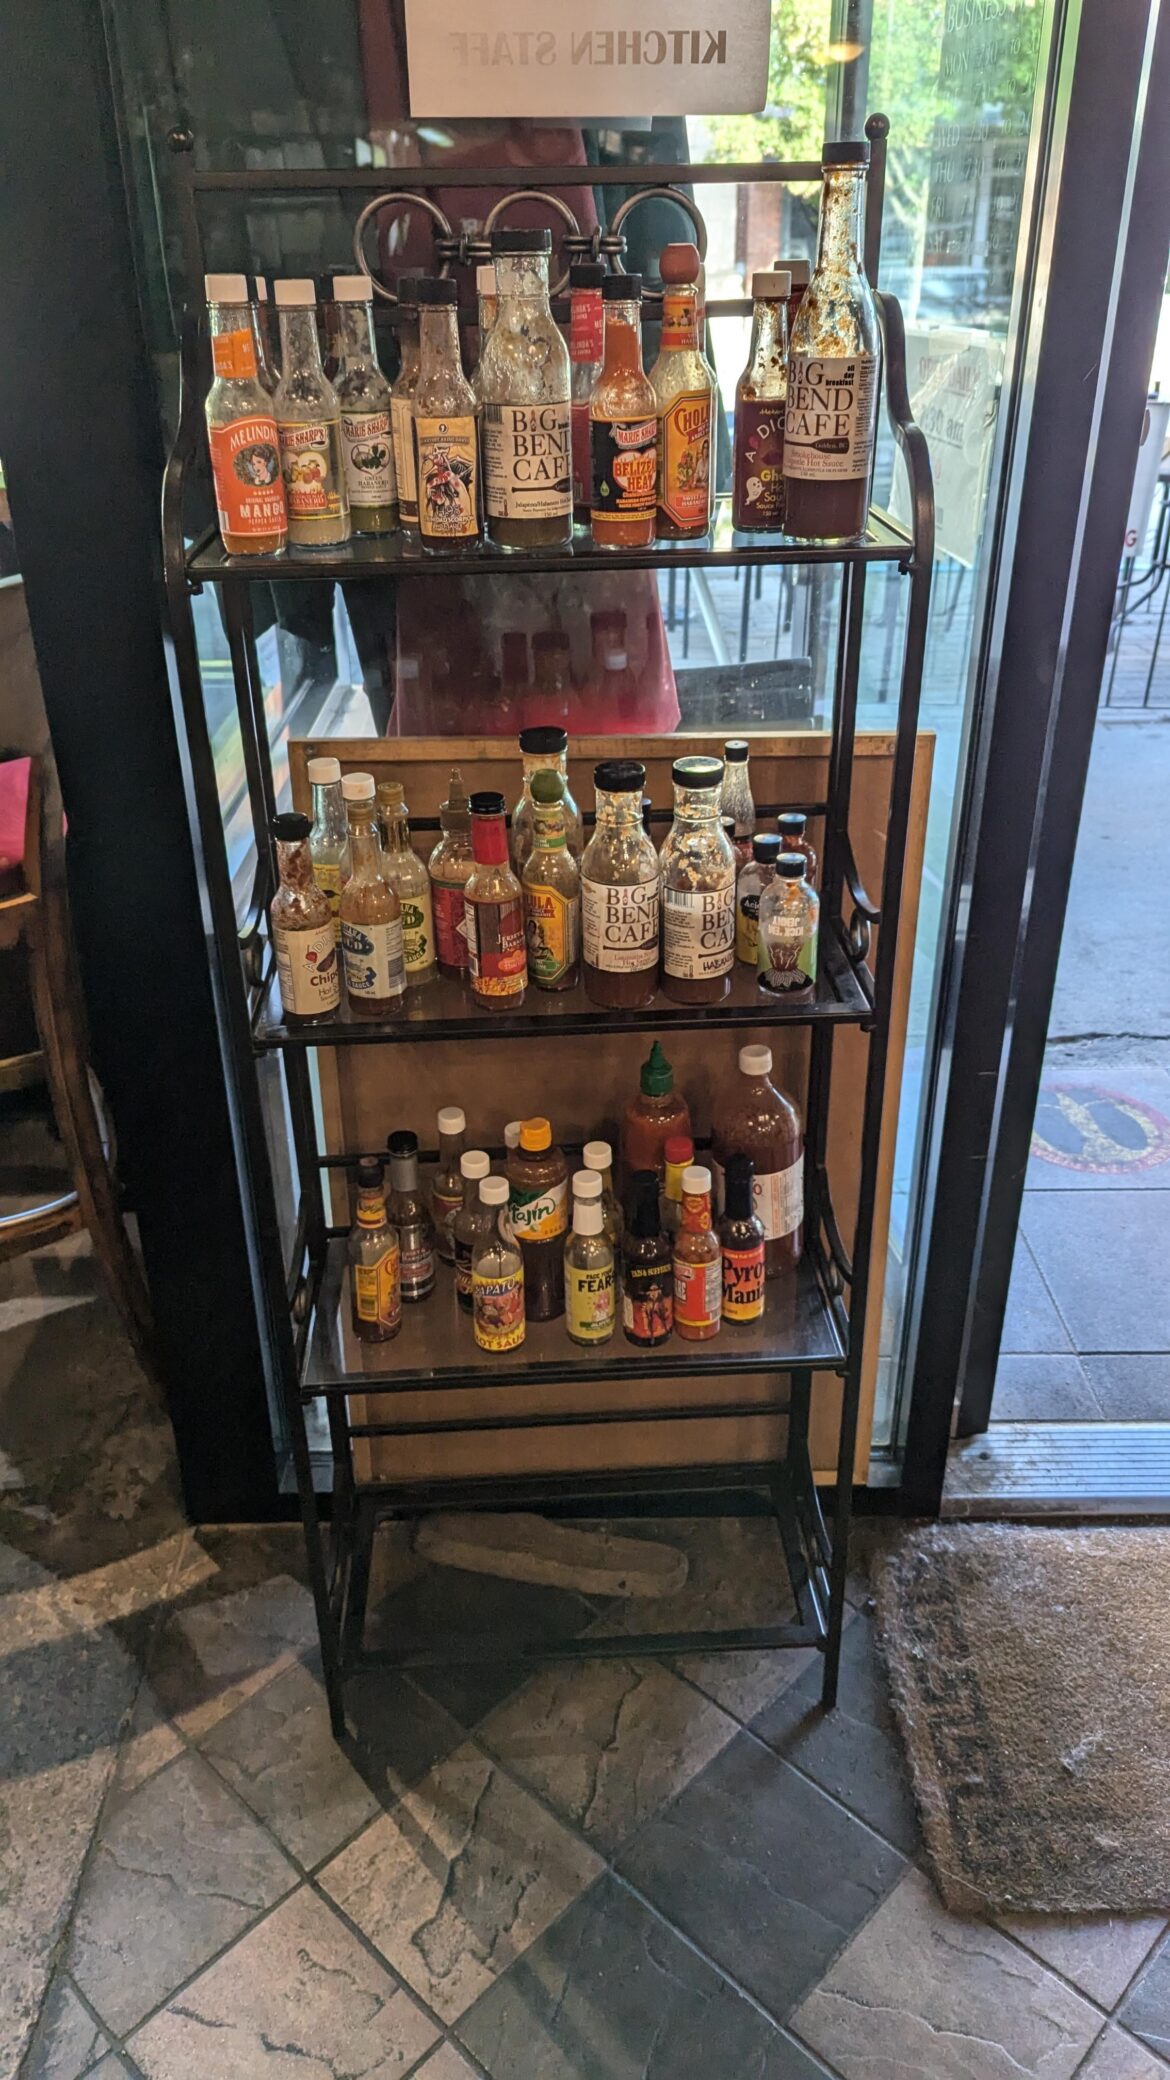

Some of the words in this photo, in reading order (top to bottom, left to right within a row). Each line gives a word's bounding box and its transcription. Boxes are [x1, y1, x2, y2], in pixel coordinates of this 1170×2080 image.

[825, 379, 854, 387] breakfast
[843, 372, 855, 380] day
[787, 386, 854, 412] BEND
[673, 403, 710, 438] CHOL
[785, 410, 850, 437] CAFE
[822, 459, 844, 468] Sauce
[627, 475, 653, 491] HEAT
[240, 501, 284, 518] MANGO
